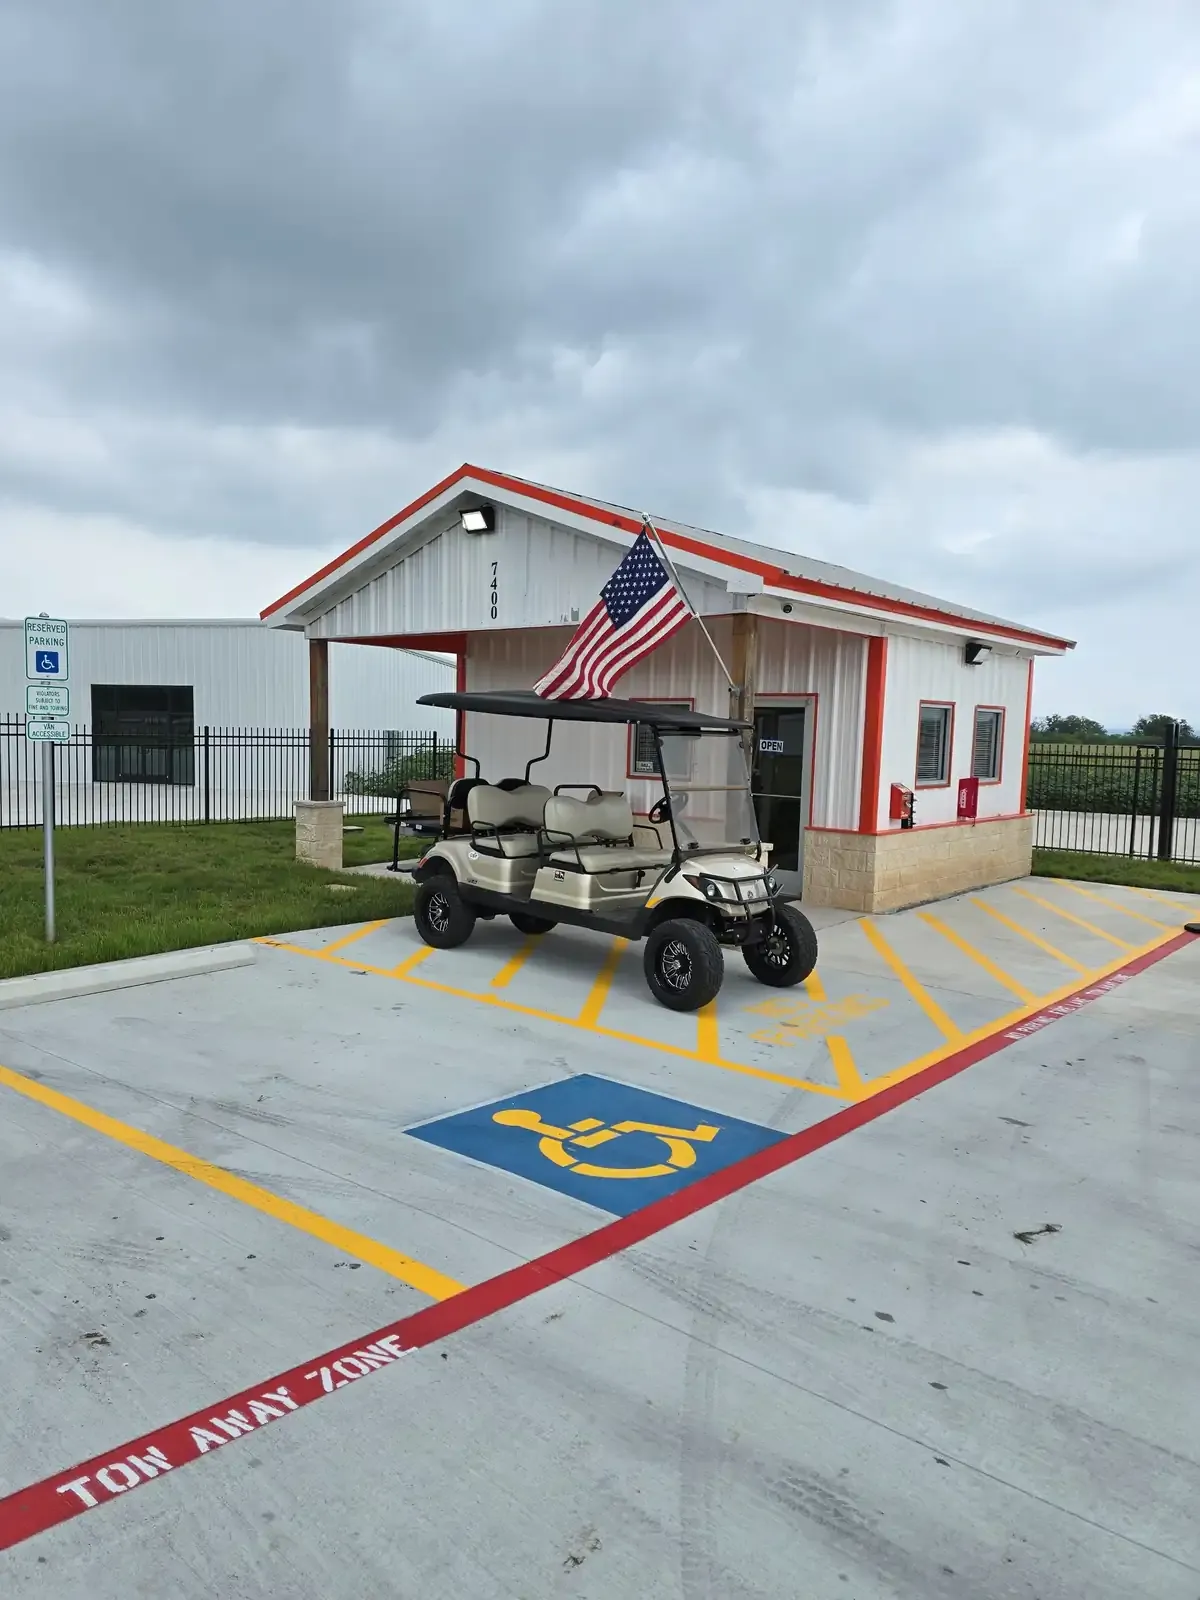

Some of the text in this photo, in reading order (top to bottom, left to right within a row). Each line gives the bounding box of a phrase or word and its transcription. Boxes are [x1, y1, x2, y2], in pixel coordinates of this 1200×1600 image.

[490, 561, 498, 620] 7400
[27, 622, 66, 633] RESERVED
[29, 636, 65, 647] PARKING
[31, 730, 66, 738] ACCESSIBLE
[761, 741, 783, 751] OPEN
[56, 1333, 419, 1507] TOW AWAY ZONE
